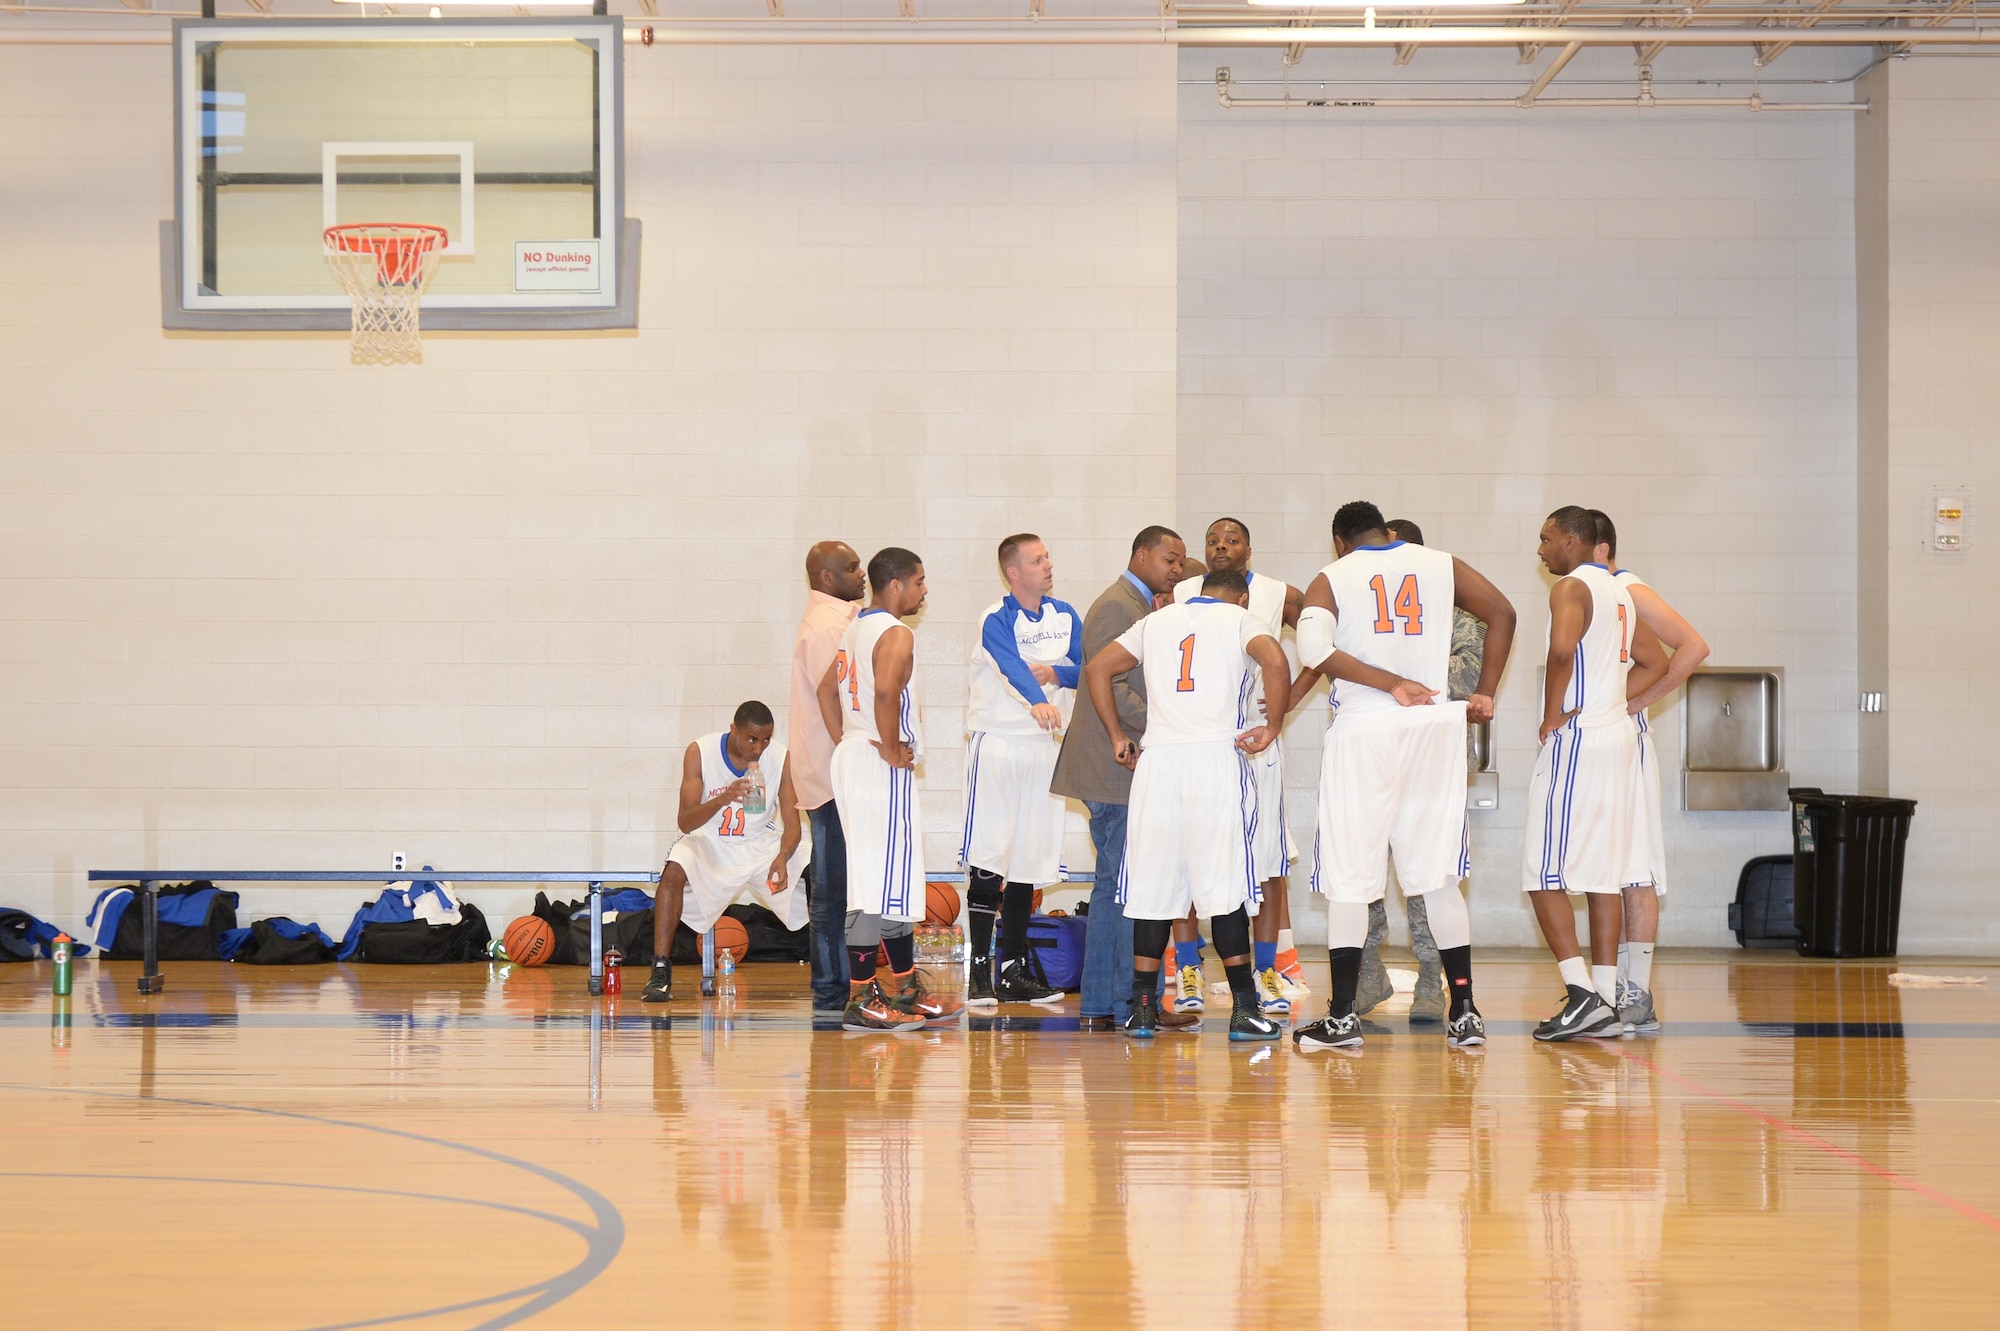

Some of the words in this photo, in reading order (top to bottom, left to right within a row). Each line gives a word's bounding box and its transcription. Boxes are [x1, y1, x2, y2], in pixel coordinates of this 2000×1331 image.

[524, 252, 542, 262] NO
[546, 252, 592, 264] Dunking
[1369, 574, 1423, 635] 14
[1176, 633, 1196, 692] 1
[718, 806, 746, 837] 11
[521, 937, 545, 964] Wilson
